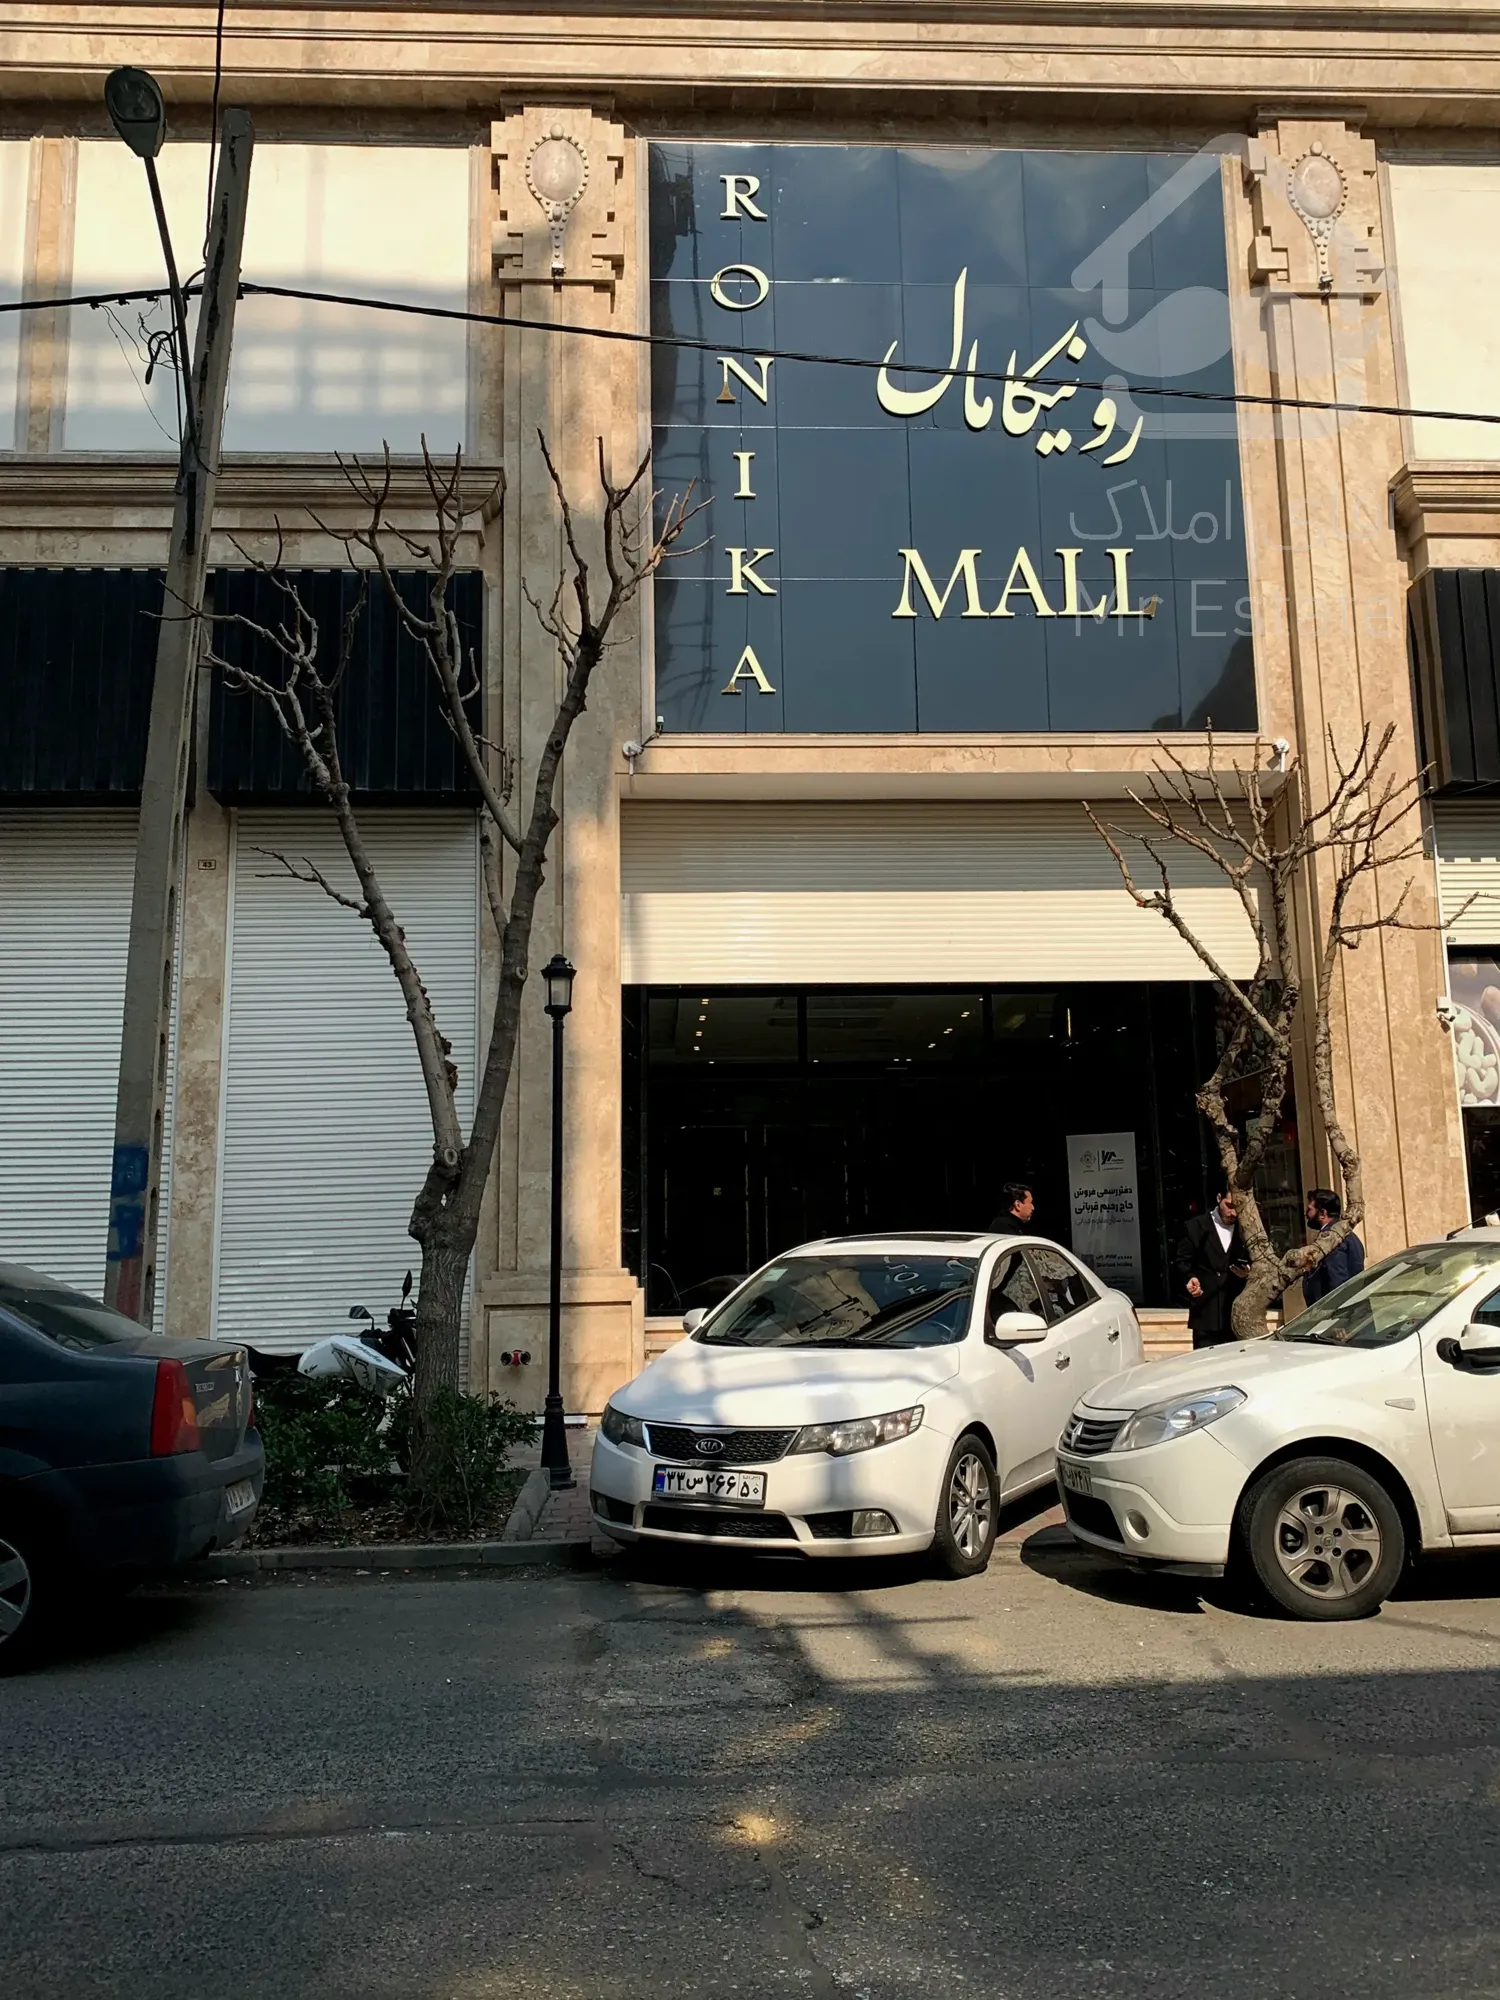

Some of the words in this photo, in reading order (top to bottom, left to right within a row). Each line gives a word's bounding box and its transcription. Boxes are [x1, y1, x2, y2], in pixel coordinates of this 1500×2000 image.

[876, 266, 994, 429] مال
[710, 174, 777, 694] RONIKA
[891, 545, 1158, 620] MALL
[1074, 1187, 1096, 1199] فروش
[700, 1441, 718, 1450] KIA
